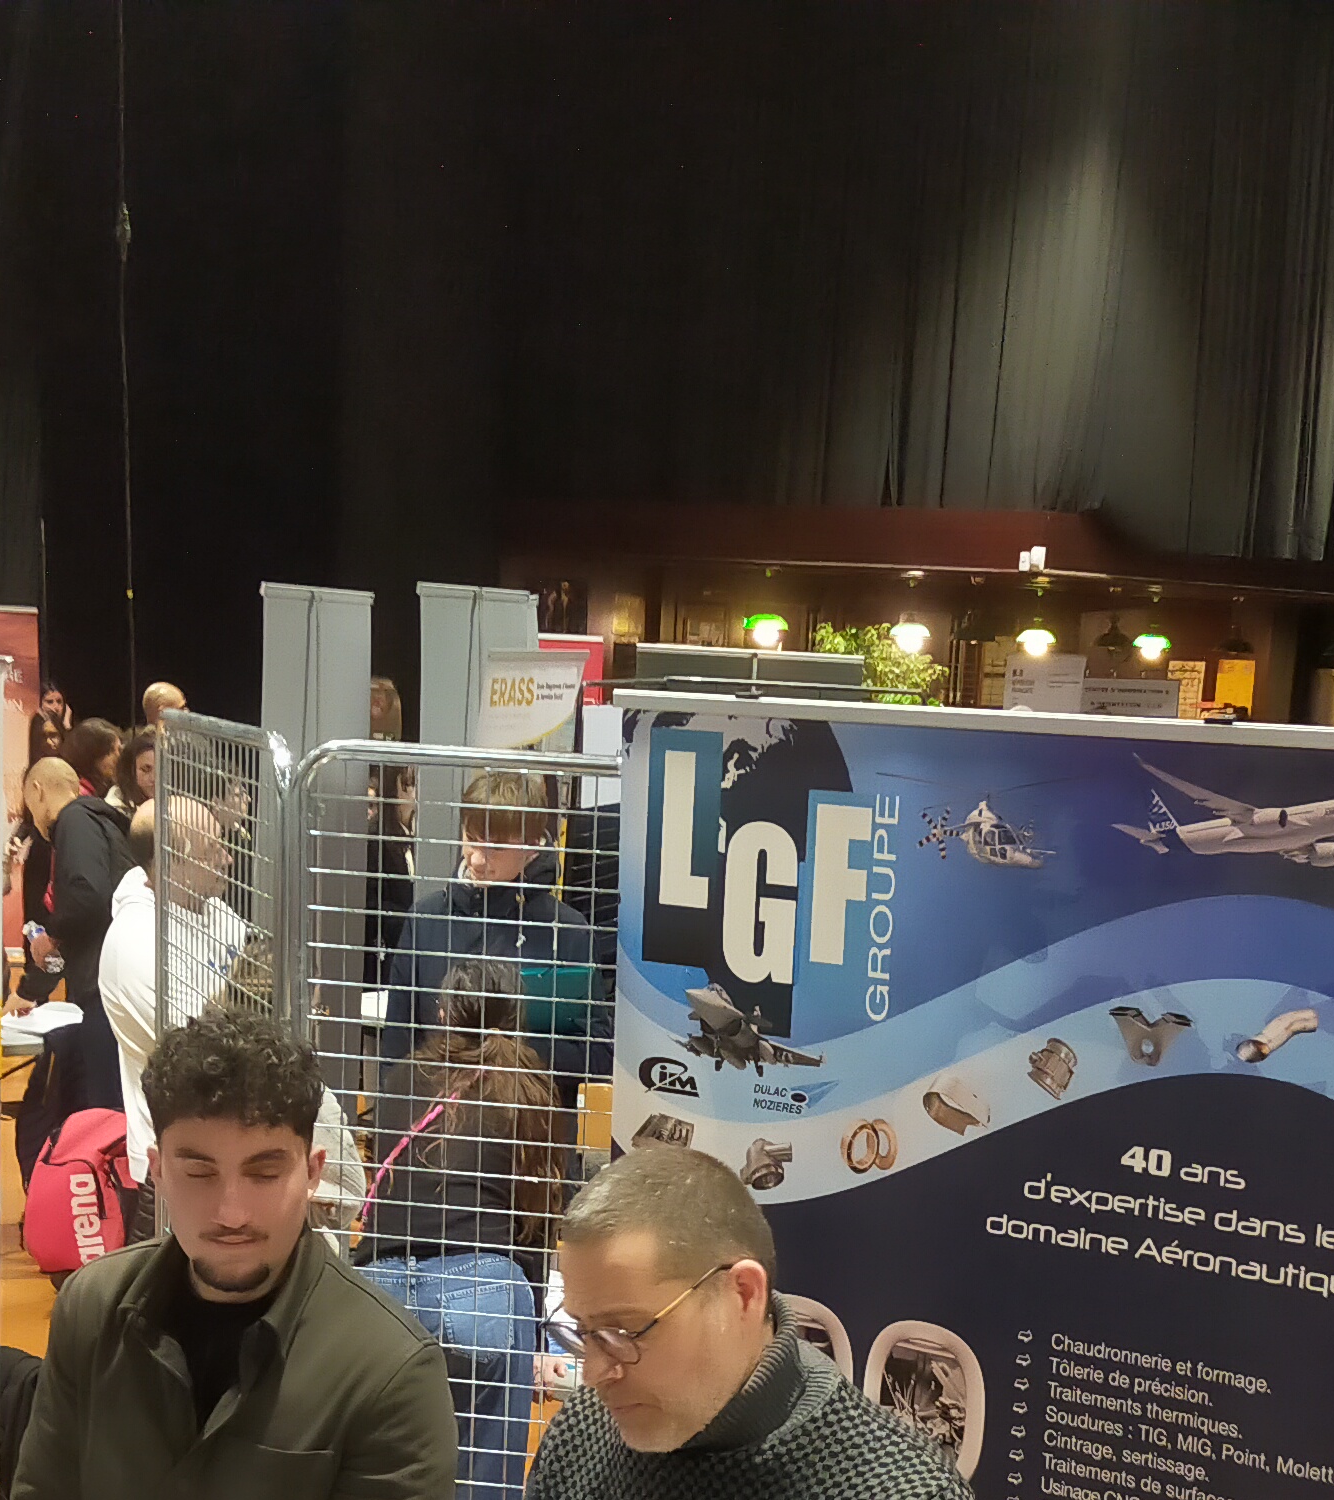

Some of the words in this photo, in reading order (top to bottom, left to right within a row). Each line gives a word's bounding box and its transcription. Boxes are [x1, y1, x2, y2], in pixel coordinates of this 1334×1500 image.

[490, 677, 535, 707] ERASS
[658, 749, 873, 984] LGF
[865, 794, 900, 1021] GROUPE
[752, 1097, 803, 1115] NOZIERES
[753, 1083, 787, 1099] DULAC
[1121, 1146, 1172, 1177] 40
[1180, 1162, 1246, 1189] ans
[69, 1173, 106, 1268] arena
[986, 1214, 1128, 1255] domaine
[1023, 1172, 1205, 1226] d'expertise
[1214, 1210, 1306, 1245] dans
[1049, 1356, 1104, 1384] Tôlerie
[1108, 1369, 1130, 1388] de
[1134, 1374, 1213, 1407] précision.
[1051, 1333, 1172, 1372] Chaudronnerie
[1176, 1360, 1192, 1377] et
[1197, 1361, 1272, 1395] formage.
[1047, 1380, 1142, 1416] Traitements
[1146, 1402, 1243, 1440] thermiques.
[1043, 1429, 1117, 1462] Cintrage,
[1121, 1448, 1210, 1482] sertissage.
[1045, 1405, 1124, 1437] Soudures
[1138, 1424, 1172, 1449] TIG,
[1177, 1433, 1217, 1460] MIG,
[1221, 1443, 1270, 1473] Point,
[1042, 1452, 1136, 1489] Traitements
[1140, 1474, 1161, 1494] de
